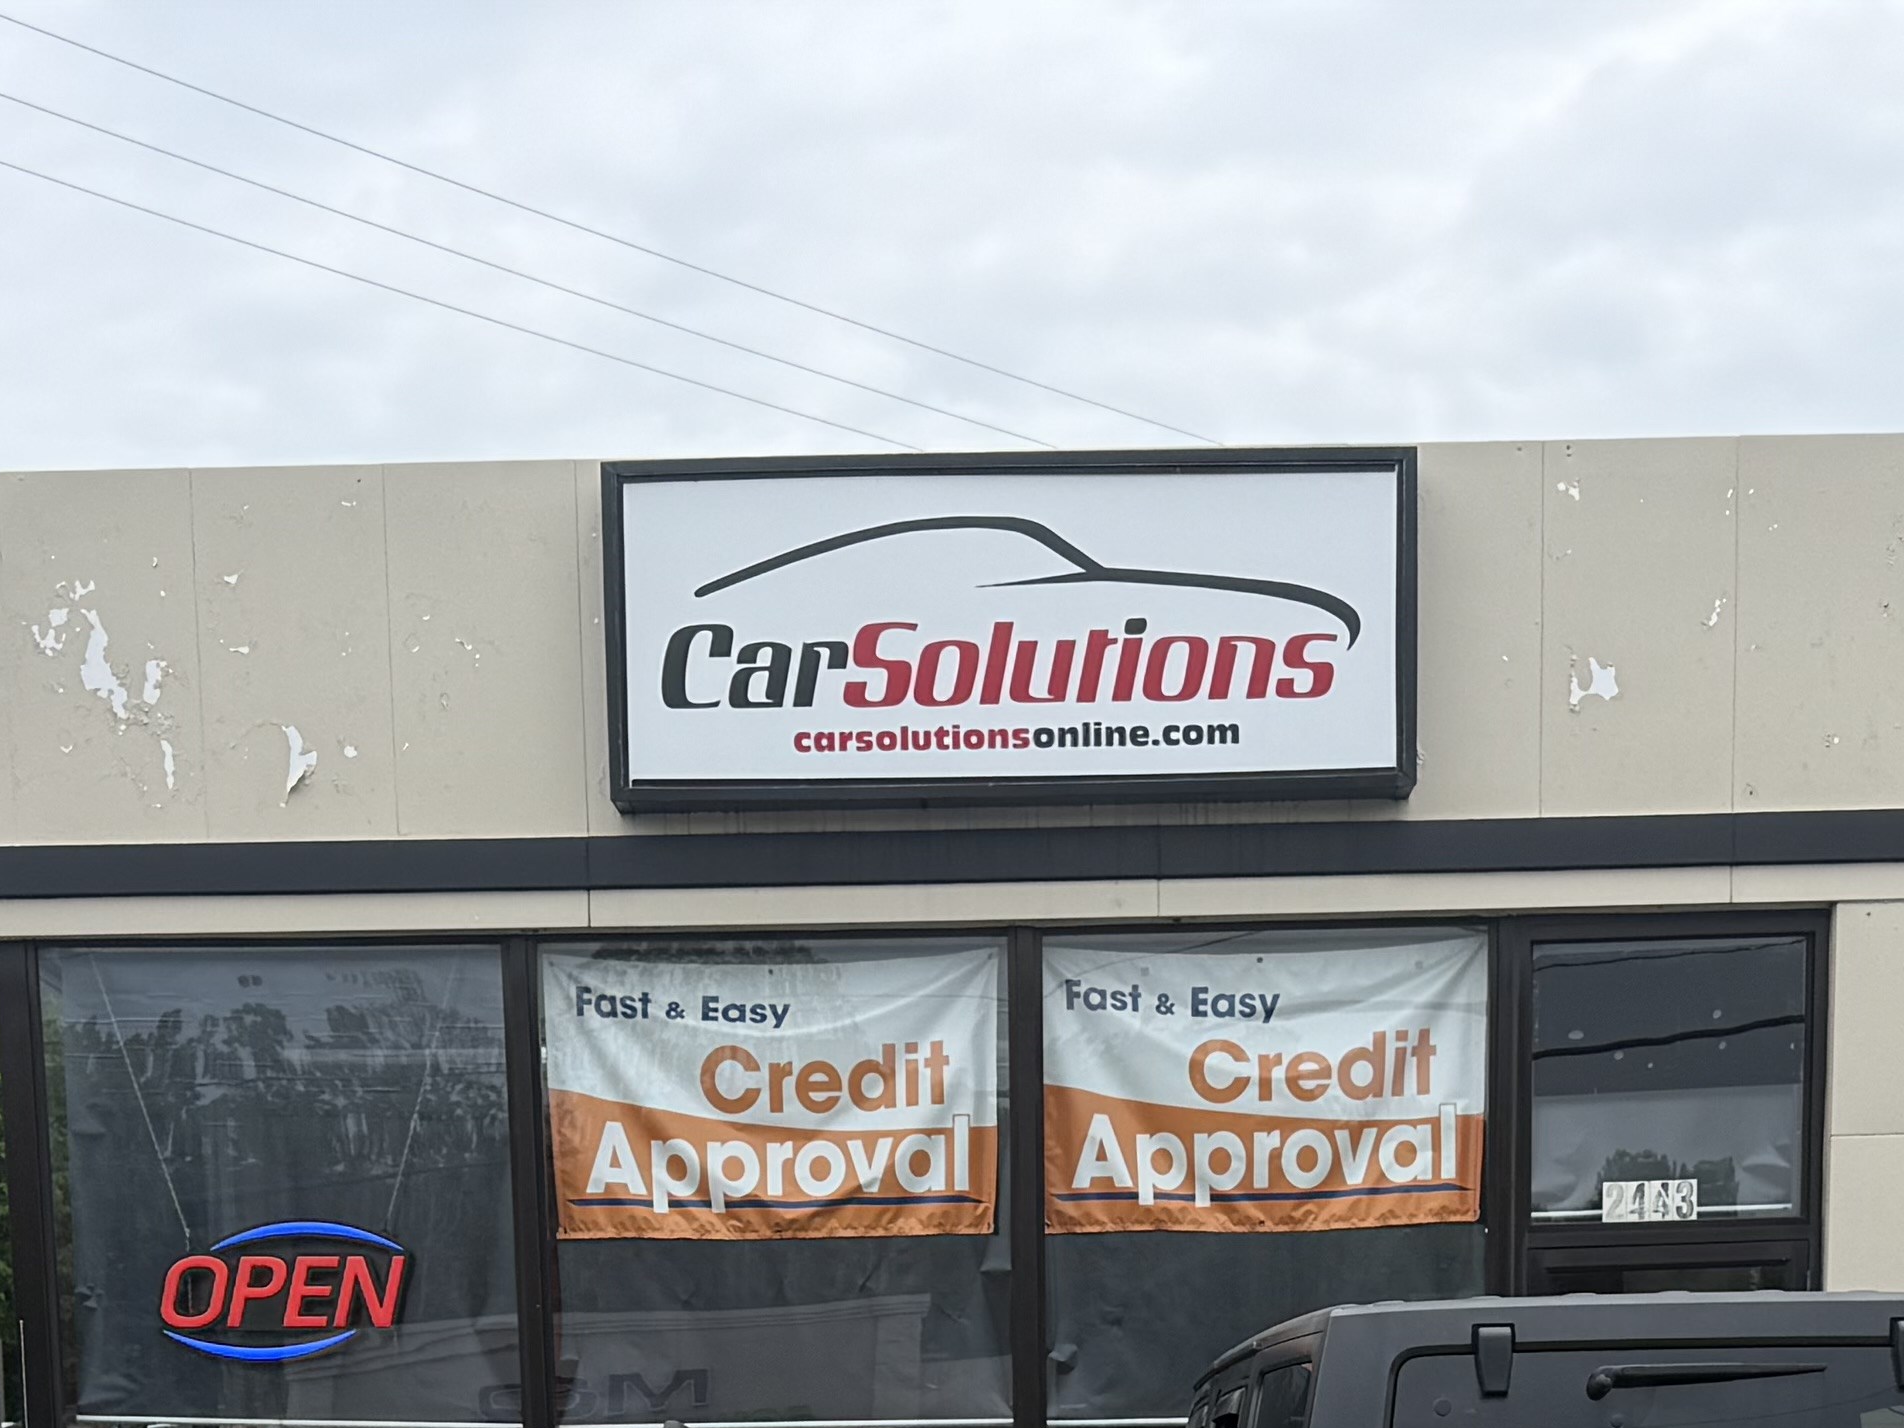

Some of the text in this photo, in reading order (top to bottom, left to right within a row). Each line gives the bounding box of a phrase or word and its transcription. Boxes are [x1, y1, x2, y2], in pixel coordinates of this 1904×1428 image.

[661, 617, 1337, 709] CarSolutions
[793, 720, 1241, 754] carsolutionsonline.com
[574, 985, 791, 1029] Fast & Easy
[1064, 979, 1280, 1024] Fast & Easy
[700, 1040, 950, 1115] Credit
[1188, 1027, 1437, 1104] Credit
[585, 1114, 971, 1214] Approval
[1071, 1103, 1457, 1208] Approval
[1605, 1181, 1694, 1220] 2443
[159, 1255, 405, 1329] OPEN
